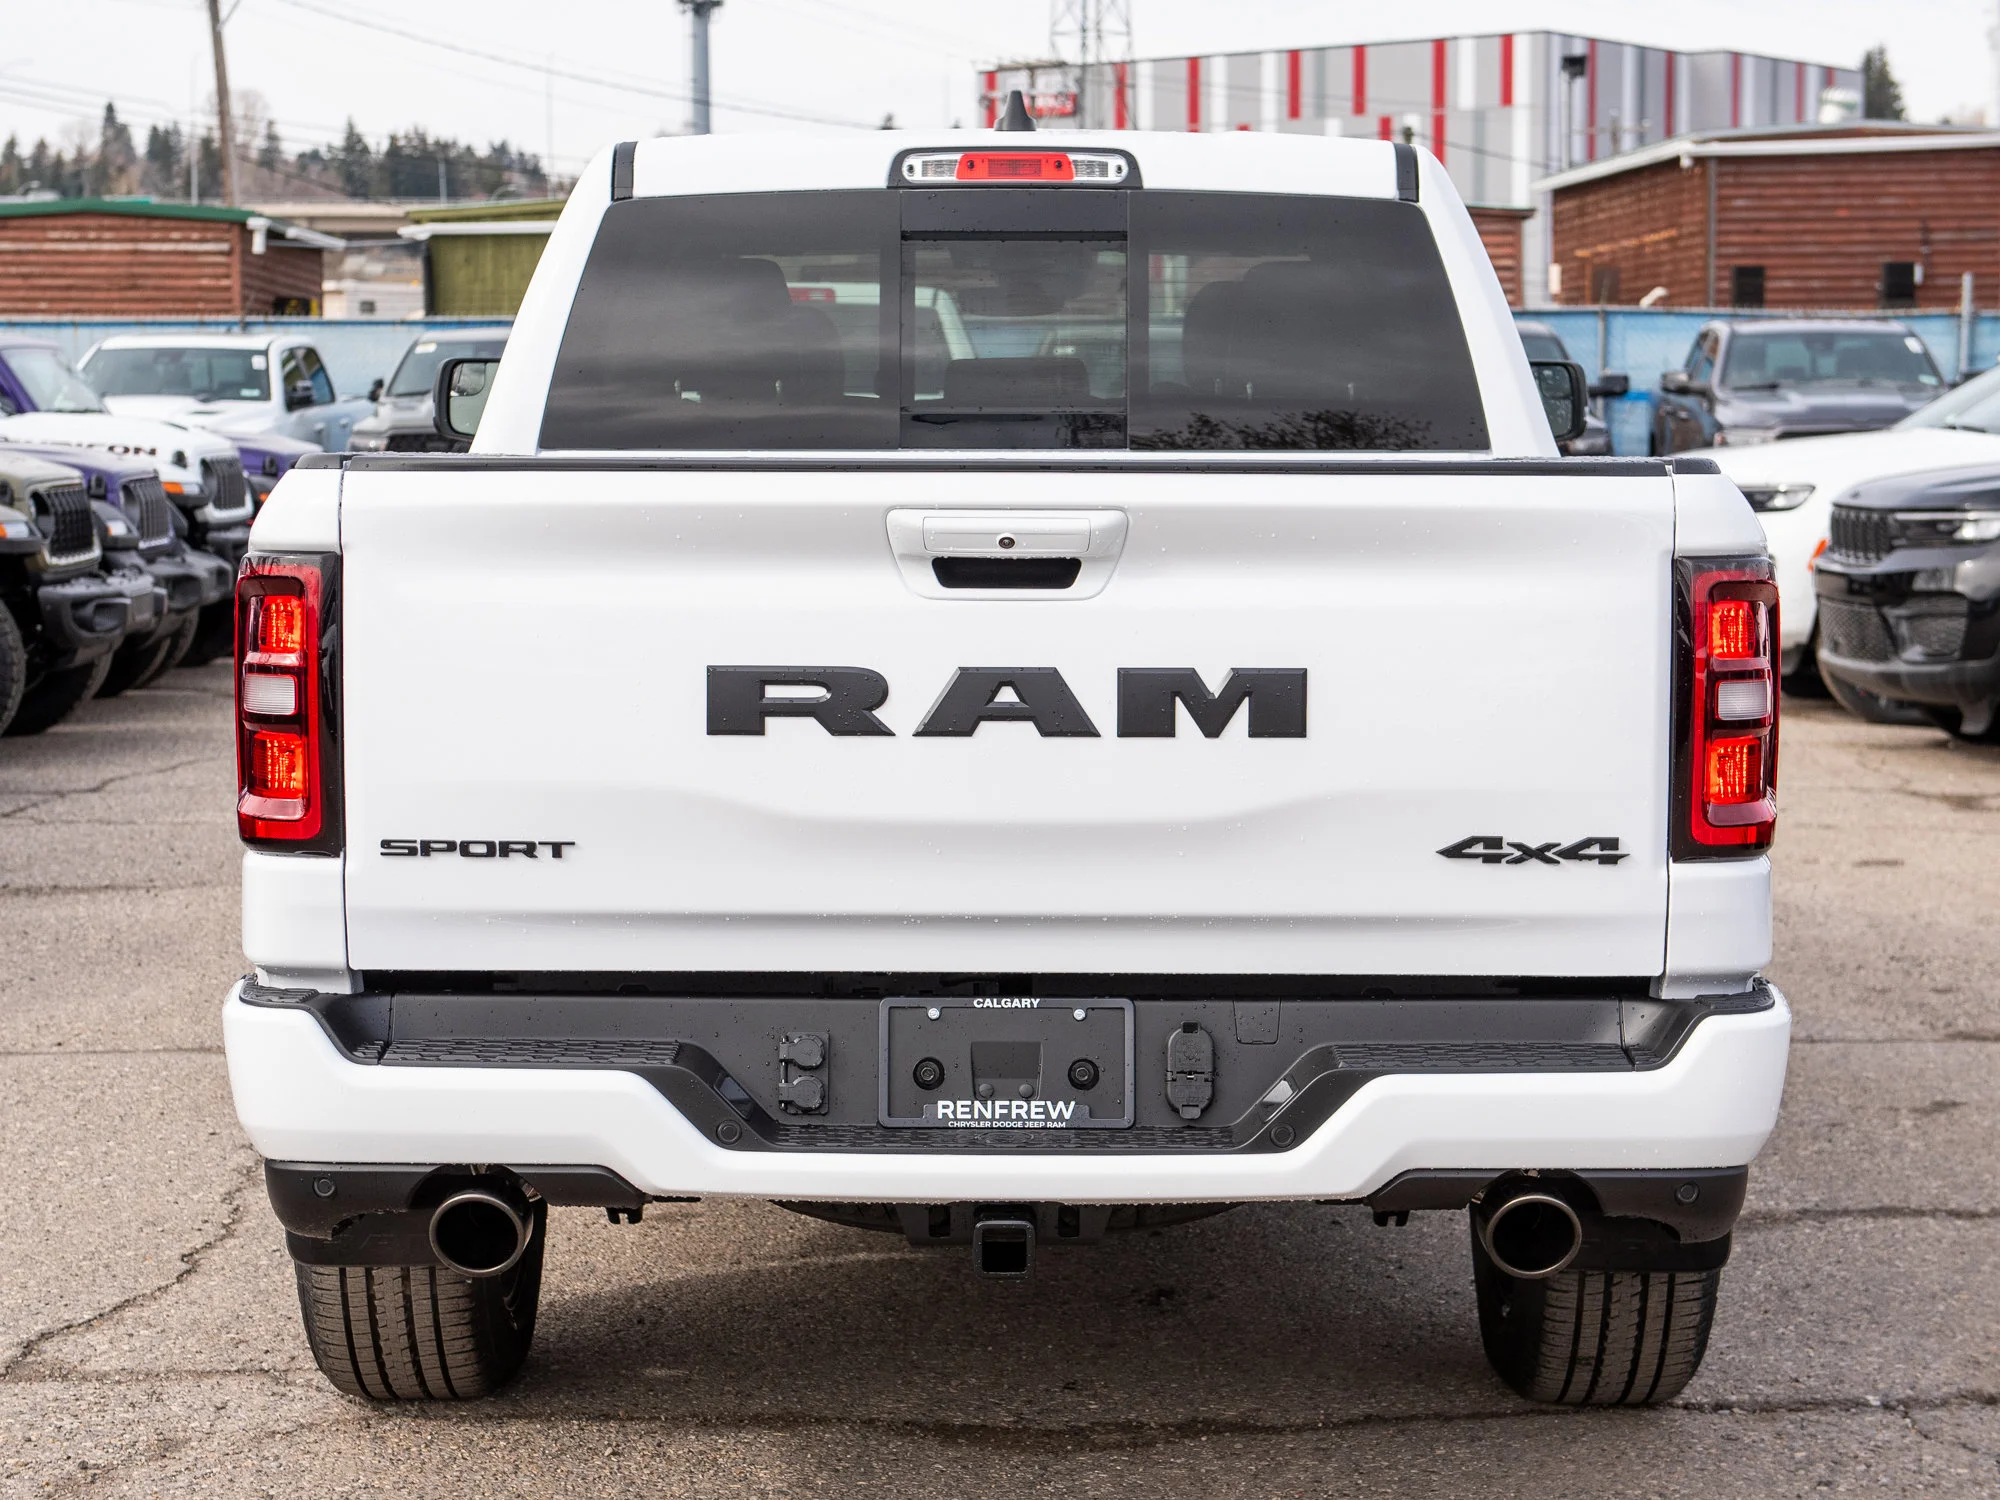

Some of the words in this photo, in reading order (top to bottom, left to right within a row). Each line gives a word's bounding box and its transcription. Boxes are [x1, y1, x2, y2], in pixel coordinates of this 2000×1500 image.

[706, 665, 1308, 738] RAM
[380, 839, 576, 859] SPORT
[1436, 835, 1631, 865] 4x4
[973, 998, 1041, 1009] CALGARY
[937, 1100, 1076, 1120] RENFREW
[948, 1120, 991, 1128] CHRYSLER
[992, 1120, 1023, 1128] DODGE
[1024, 1120, 1045, 1128] JEEP
